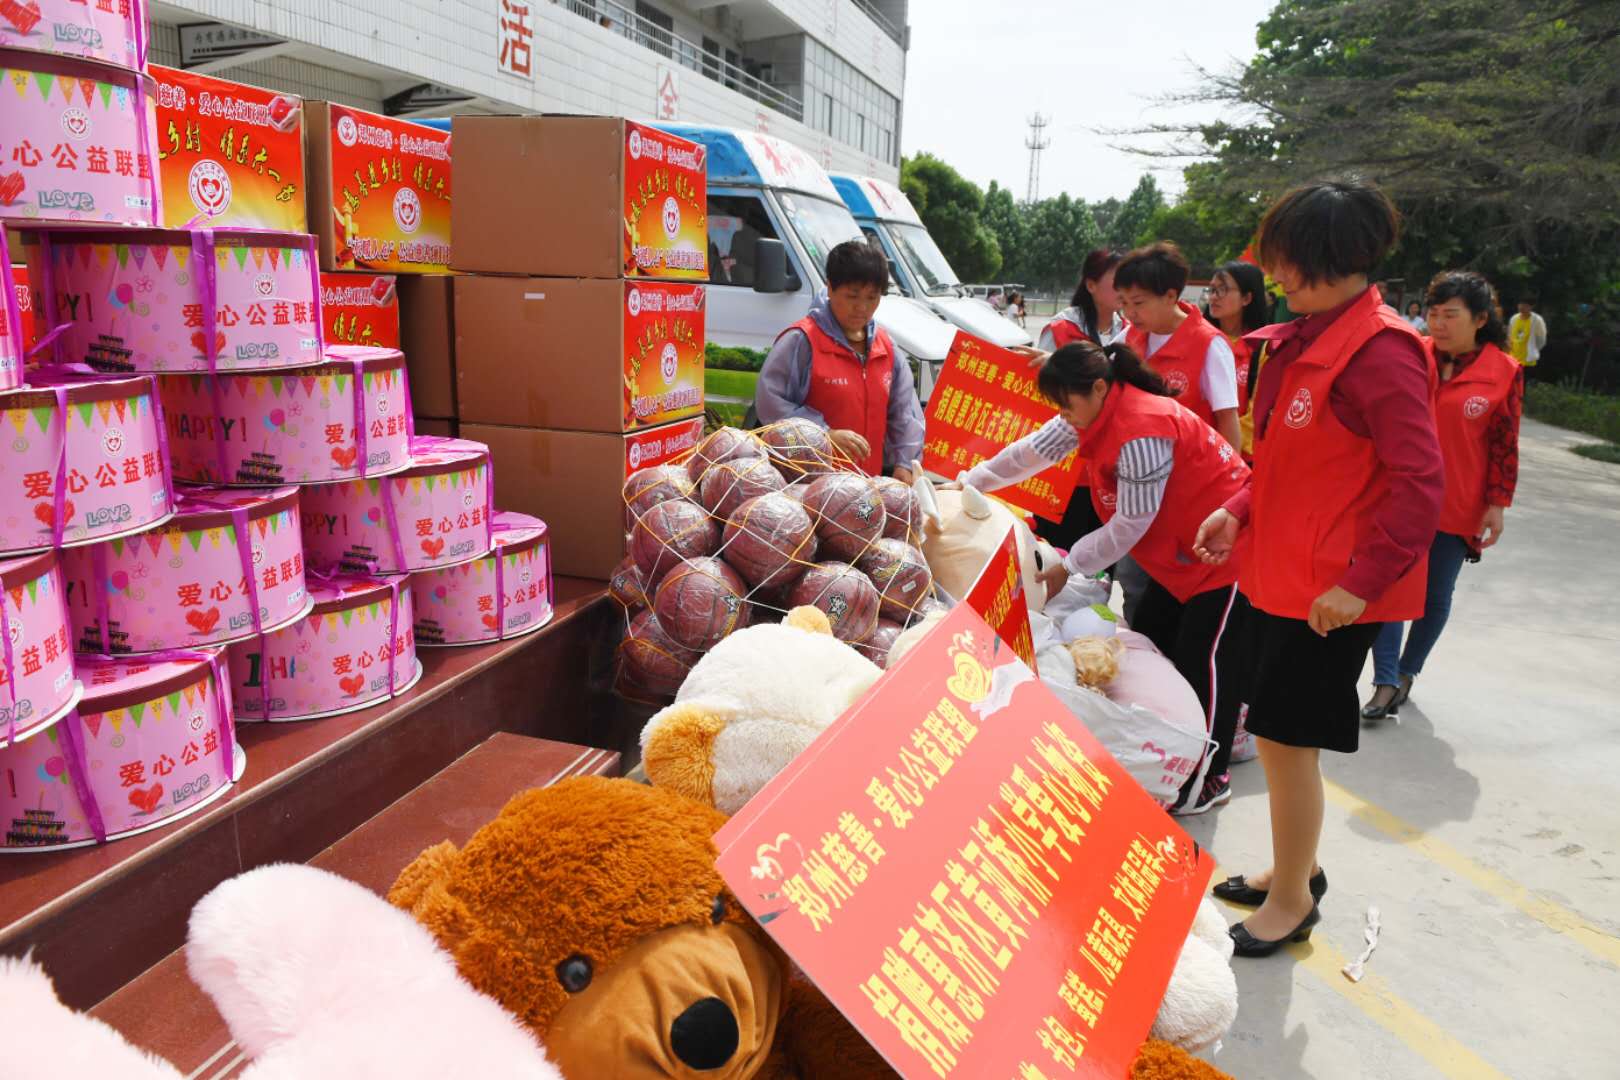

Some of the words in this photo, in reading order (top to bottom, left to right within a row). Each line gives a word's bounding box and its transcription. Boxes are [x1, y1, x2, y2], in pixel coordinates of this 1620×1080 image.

[499, 0, 533, 76] 活
[0, 139, 152, 181] 心公益联盟
[782, 697, 979, 932] 郑州慈善·爱心公益联盟
